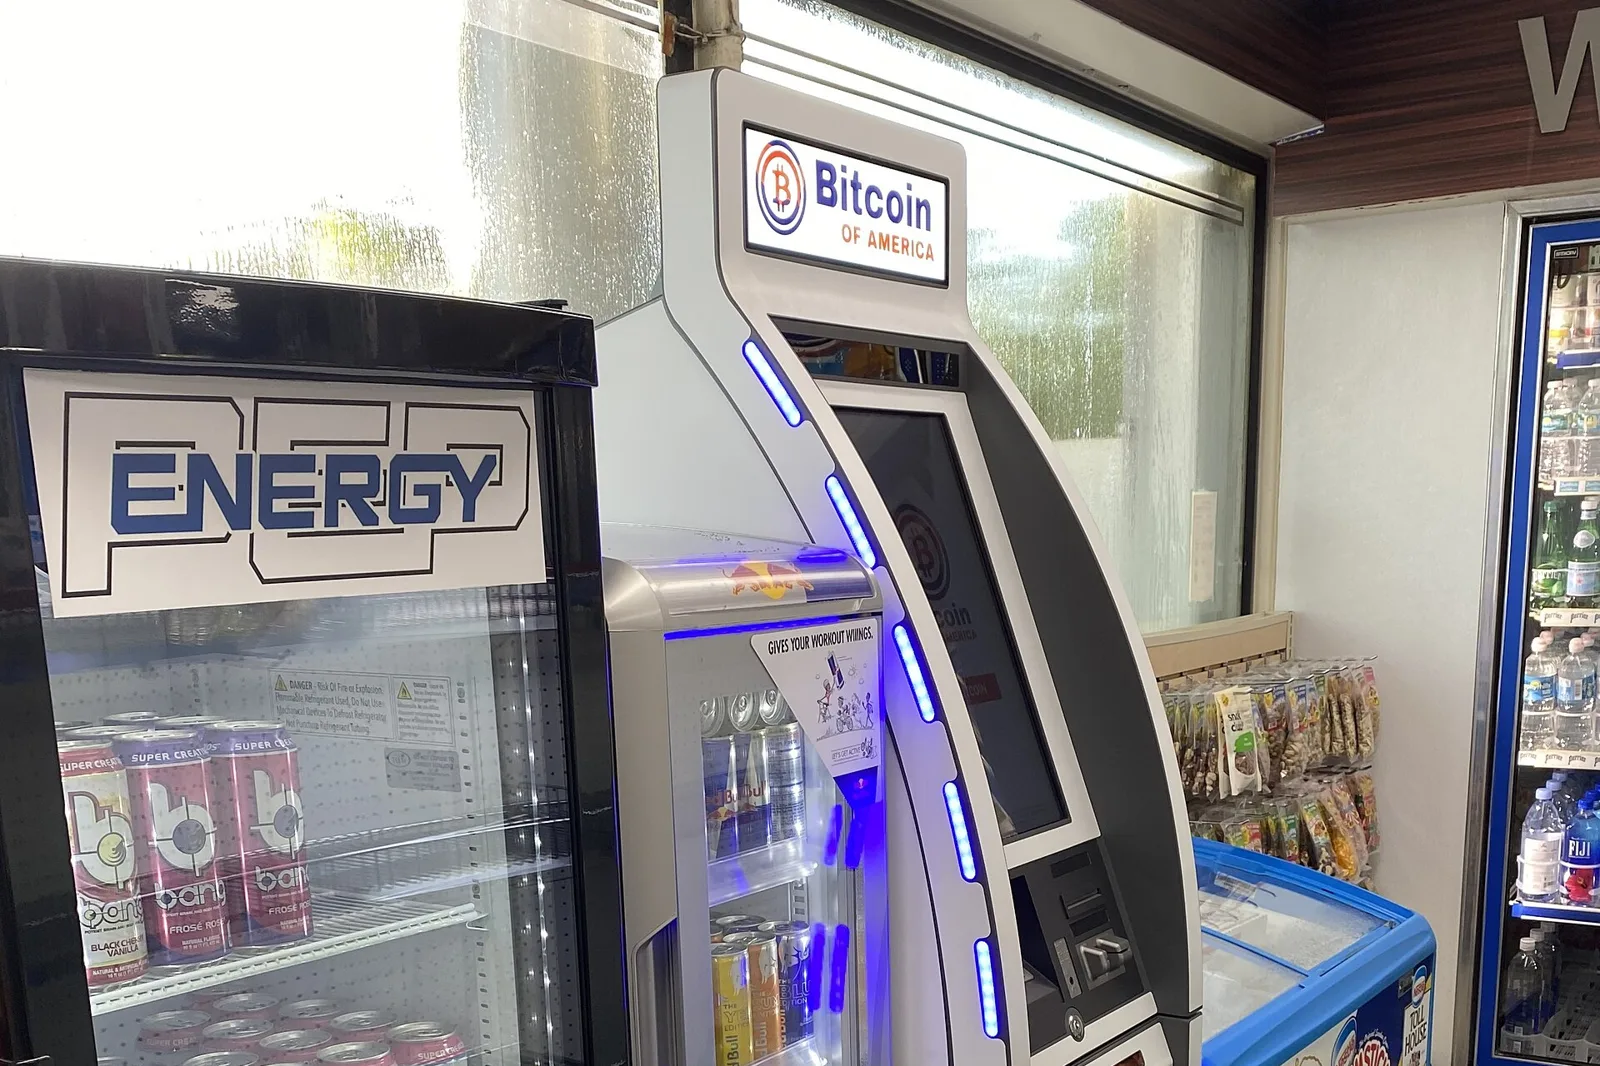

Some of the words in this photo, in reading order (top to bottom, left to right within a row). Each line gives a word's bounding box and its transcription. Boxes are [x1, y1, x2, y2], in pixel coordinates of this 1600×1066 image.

[815, 159, 931, 231] Bitcoin
[841, 223, 861, 244] OF
[868, 230, 934, 261] AMERICA
[111, 453, 497, 534] ENERGY
[768, 638, 789, 655] GIVES
[790, 635, 810, 652] YOUR
[810, 630, 845, 649] WORKOUT
[289, 680, 313, 690] DANGER
[131, 752, 170, 763] SUPER
[235, 741, 272, 751] SUPER
[1568, 839, 1591, 857] FIJI
[154, 879, 227, 911] bang
[169, 922, 203, 935] FROSÉ
[91, 940, 120, 952] BLACK
[107, 944, 139, 957] VANILLA
[1409, 1004, 1425, 1032] TOLL
[725, 1035, 740, 1061] Bull
[1404, 1021, 1427, 1057] HOUSE
